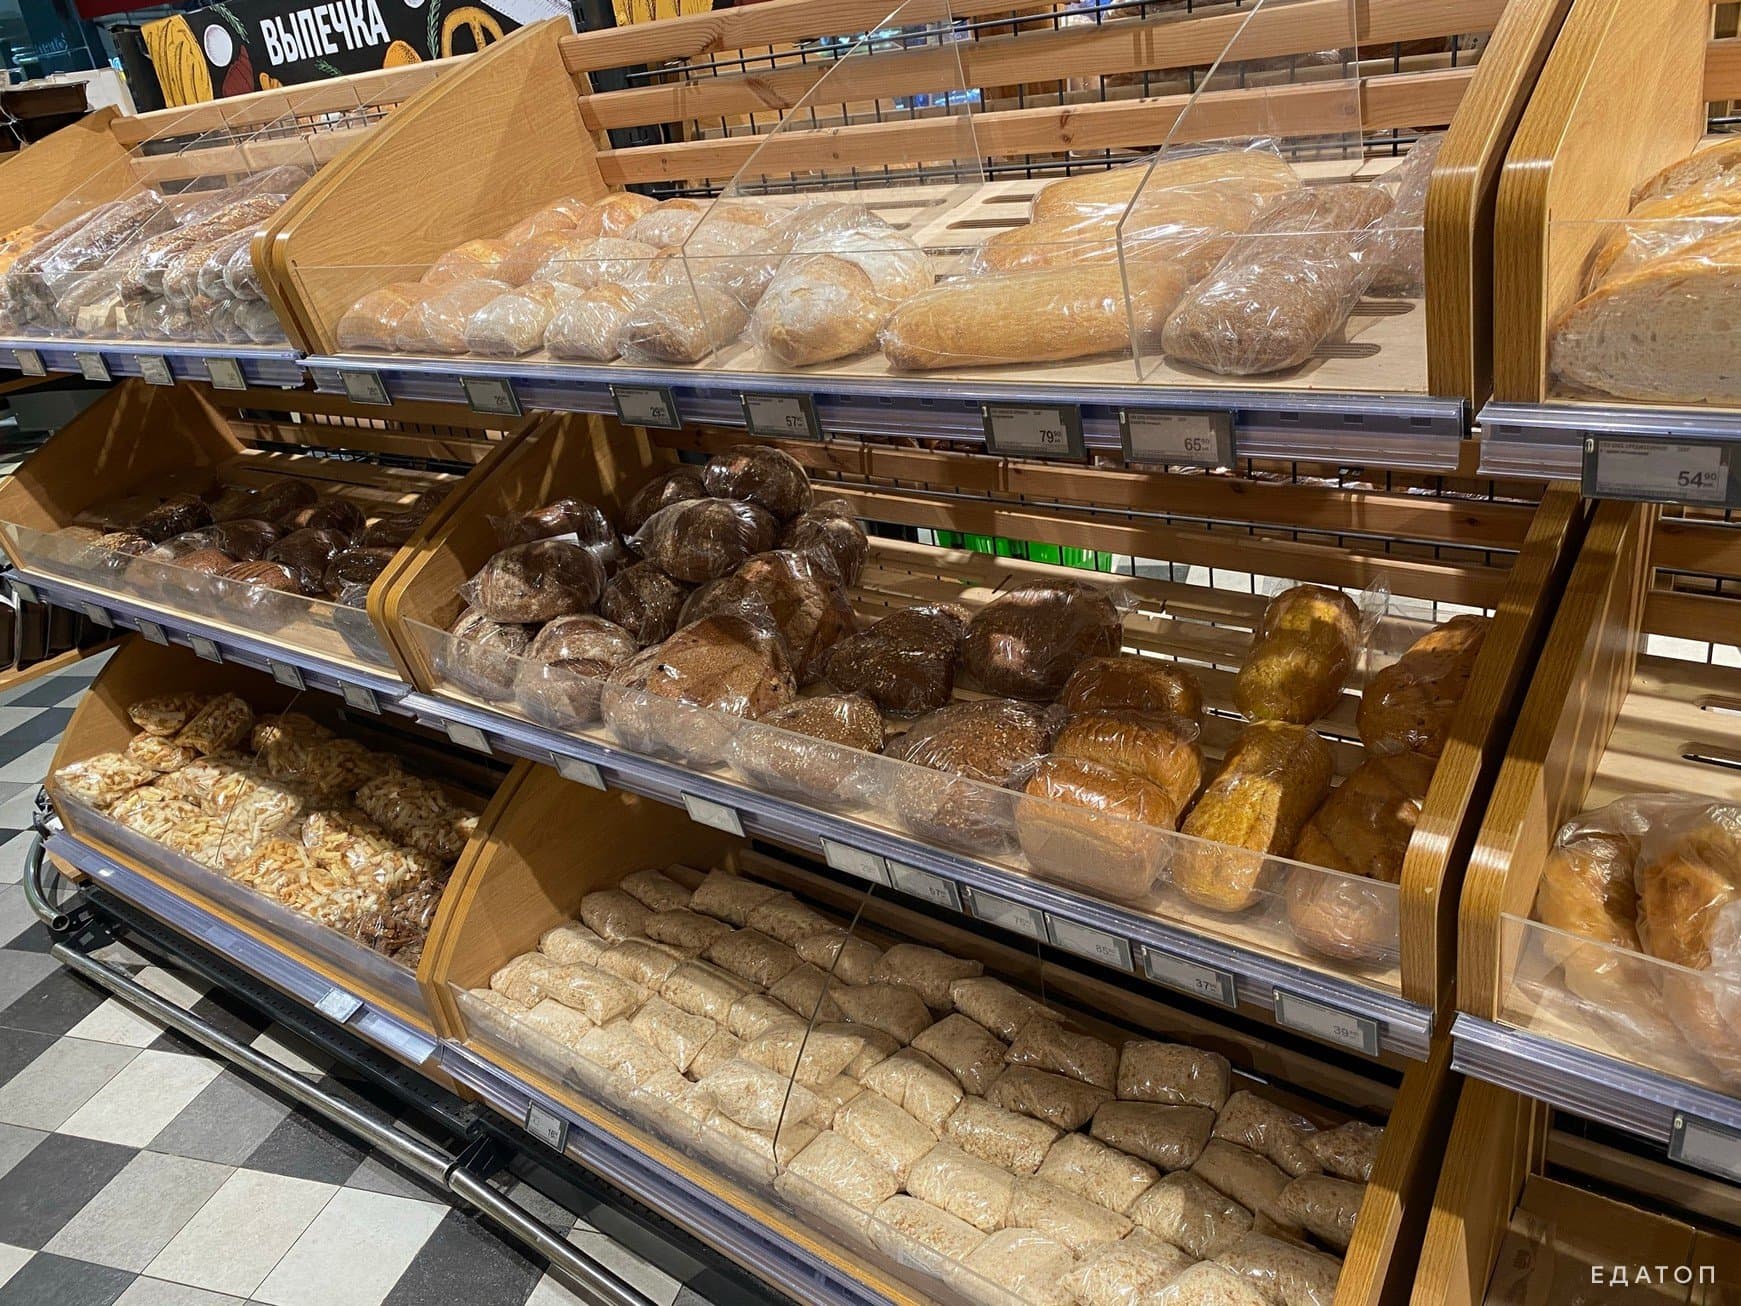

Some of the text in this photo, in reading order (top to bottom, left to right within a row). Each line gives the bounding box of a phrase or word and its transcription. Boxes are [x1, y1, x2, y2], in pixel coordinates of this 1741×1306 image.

[259, 0, 391, 66] ВЫПЕЧКА
[1039, 430, 1054, 443] 79
[1184, 438, 1201, 451] 65
[1677, 471, 1703, 488] 54
